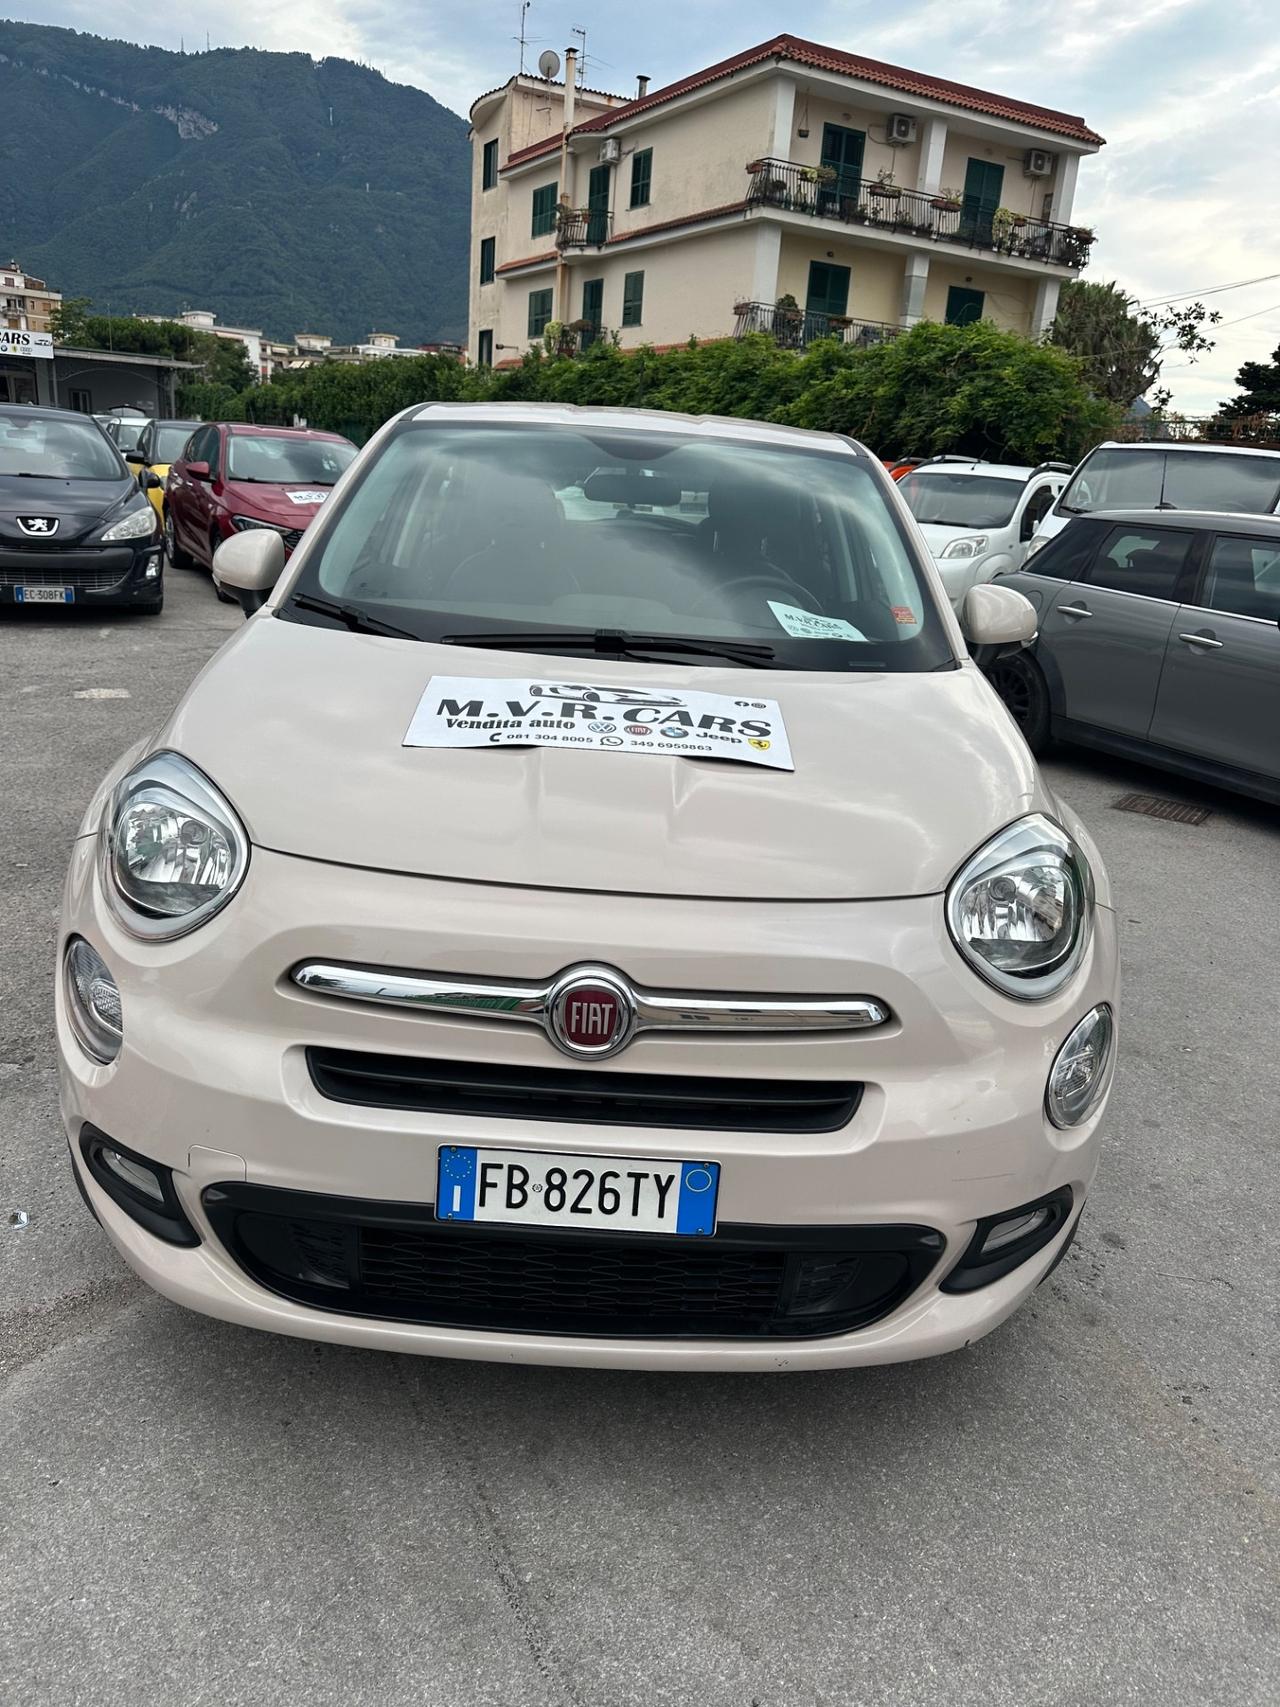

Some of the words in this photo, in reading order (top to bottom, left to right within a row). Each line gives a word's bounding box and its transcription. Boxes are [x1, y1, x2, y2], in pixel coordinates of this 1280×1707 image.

[446, 718, 522, 730] Vendita
[528, 719, 576, 730] auto
[534, 733, 558, 741] 304
[561, 735, 593, 743] 8005
[696, 731, 743, 745] Jeep
[630, 739, 655, 748] 349
[657, 741, 713, 752] 6959863
[571, 1001, 614, 1035] FIAT
